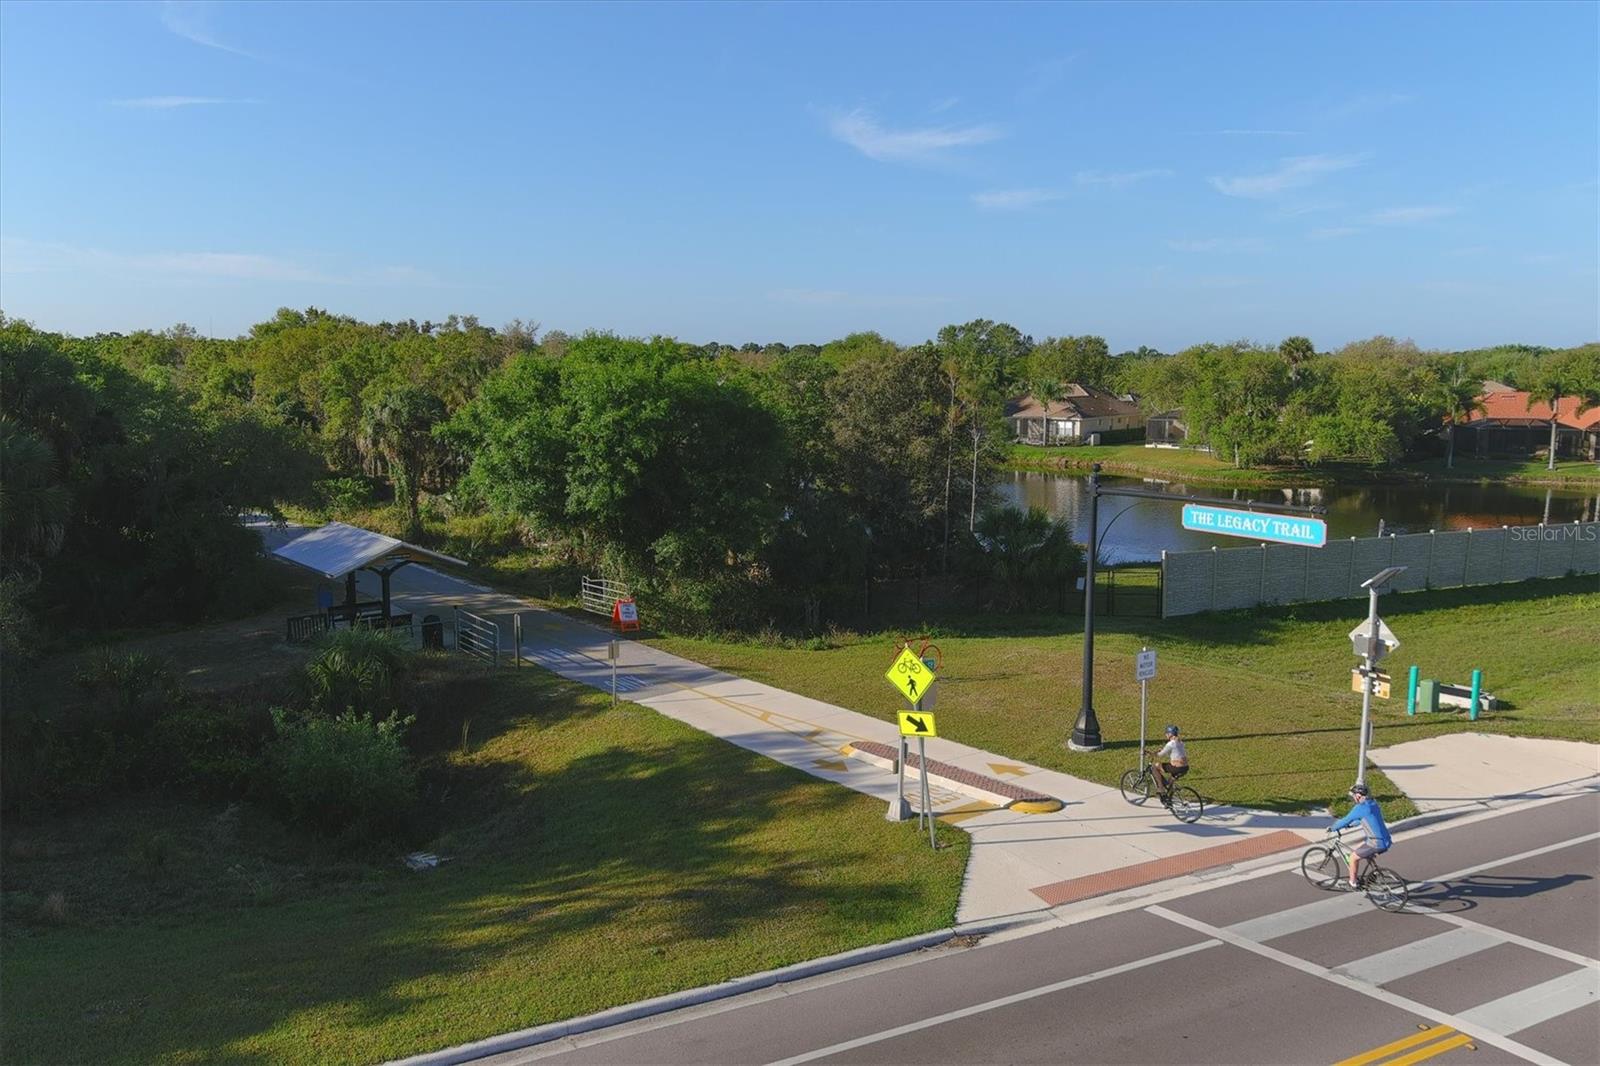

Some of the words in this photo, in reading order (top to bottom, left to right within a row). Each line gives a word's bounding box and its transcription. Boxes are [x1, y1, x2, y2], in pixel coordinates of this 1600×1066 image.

[1191, 511, 1214, 526] THE
[1217, 515, 1271, 532] LEGACY
[1272, 521, 1314, 539] TRAIL
